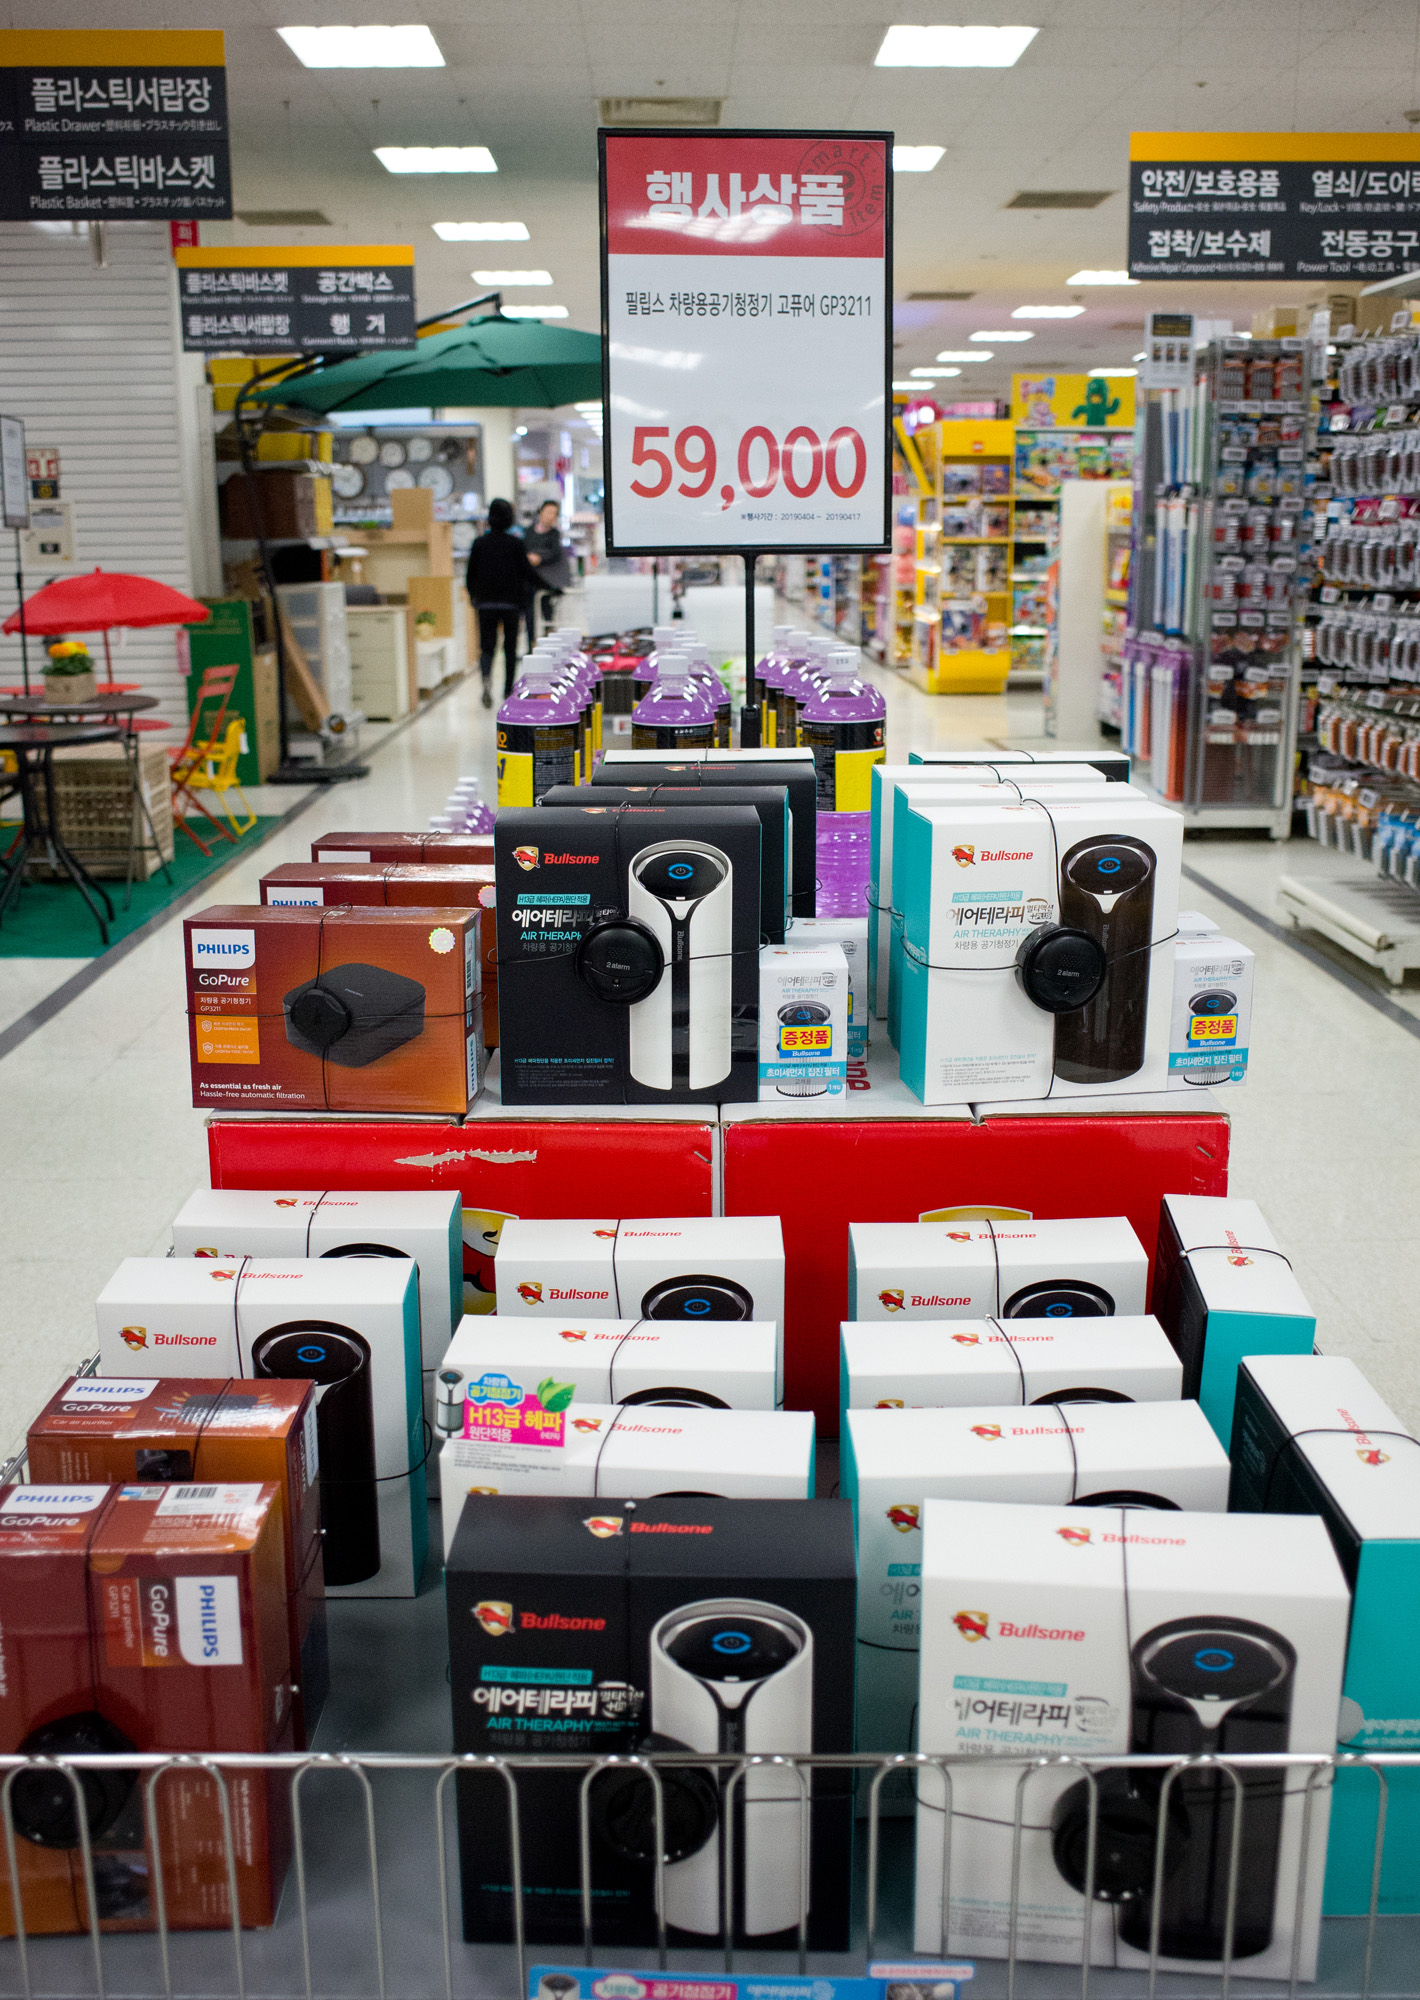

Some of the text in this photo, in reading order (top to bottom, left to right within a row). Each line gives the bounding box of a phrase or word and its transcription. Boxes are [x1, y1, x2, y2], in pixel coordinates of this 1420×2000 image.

[31, 77, 212, 113] 플라스틱서랍장
[25, 119, 59, 132] Plastic
[61, 119, 101, 132] Drawer
[38, 154, 215, 190] 플라스틱바스켓
[1141, 169, 1281, 198] 안전/보호용품
[30, 196, 102, 209] Plastic Basket
[645, 169, 844, 226] 행사상품
[1147, 229, 1271, 258] 접착/보수제
[1320, 229, 1420, 258] 전동공구
[1330, 261, 1351, 273] Tool
[185, 271, 289, 293] 플라스틱바스켓
[316, 270, 394, 293] 공간박스
[625, 291, 871, 318] 필립스 차량용공기청정기 고퓨어 GP3211
[187, 313, 290, 336] 플라스틱서랍장
[629, 425, 867, 511] 59,000
[543, 852, 600, 865] Bullsone
[980, 850, 1034, 862] Bullsone
[946, 905, 1026, 926] 에어테라피
[520, 931, 537, 940] AIR
[953, 928, 1021, 939] AIR THERAPHY
[197, 943, 250, 955] PHILIPS
[954, 939, 1019, 950] 차량용 공기청정기
[198, 974, 250, 987] GoPure
[200, 996, 252, 1005] 차량용 공기청정기
[1193, 1019, 1235, 1036] 증정품
[783, 1029, 829, 1046] 증정품
[792, 1050, 821, 1058] Bullsone
[766, 1067, 840, 1077] 초미세먼지 집진 필터
[200, 1090, 240, 1098] Hassle-free
[623, 1230, 682, 1238] Bullsone
[240, 1272, 304, 1281] Bullsone
[549, 1287, 610, 1301] Bullsone
[910, 1294, 972, 1308] Bullsone
[153, 1333, 217, 1346] Bullsone
[75, 1386, 145, 1394] PHILIPS
[62, 1402, 132, 1413] GoPure
[469, 1406, 562, 1432] H13급 헤파
[469, 1426, 513, 1442] 원단적용
[610, 1421, 683, 1435] Bullsone
[1010, 1425, 1085, 1437] Bullsone
[15, 1494, 95, 1504] PHILIPS
[1, 1515, 80, 1526] GoPure
[629, 1522, 713, 1535] Bullsone
[1102, 1532, 1186, 1547] Bullsone
[150, 1585, 170, 1657] GoPure
[199, 1585, 219, 1658] PHILIPS
[520, 1612, 606, 1633] Bullsone
[997, 1621, 1085, 1642] Bullsone
[472, 1686, 598, 1717] 에어테라피
[486, 1716, 512, 1730] AIR
[514, 1717, 594, 1732] THERAPHY
[956, 1726, 981, 1738] AIR
[985, 1728, 1063, 1746] THERAPHY
